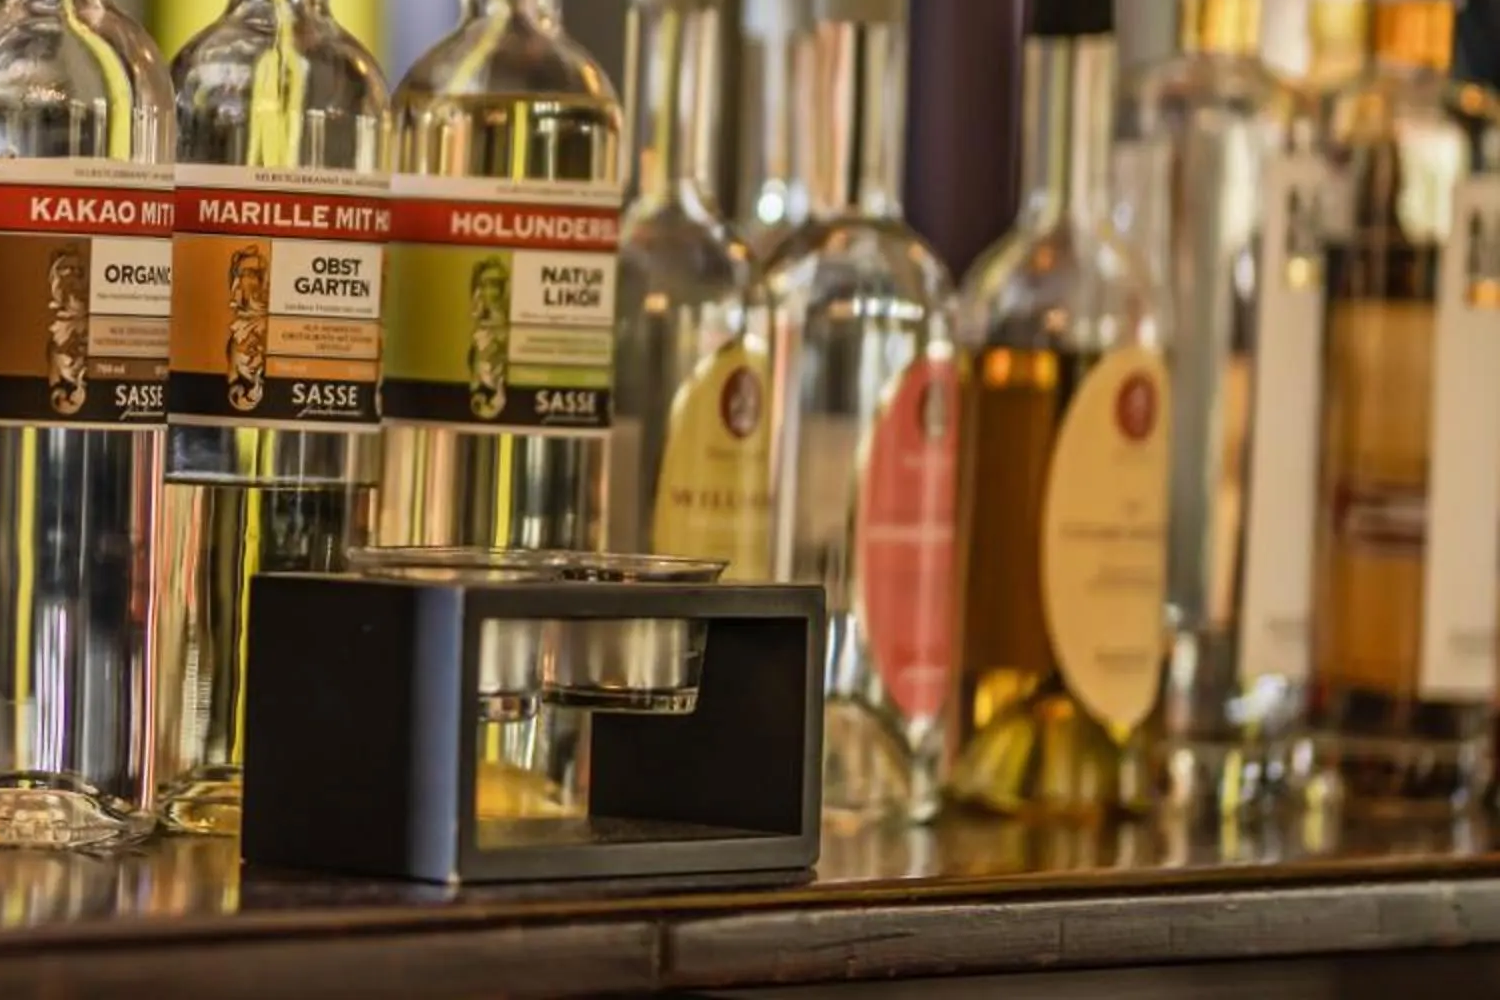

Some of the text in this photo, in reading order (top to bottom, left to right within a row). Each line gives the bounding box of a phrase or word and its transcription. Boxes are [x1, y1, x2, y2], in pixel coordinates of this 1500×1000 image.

[30, 197, 136, 225] KAKAO
[200, 200, 330, 229] MARILLE
[335, 206, 373, 232] MIT
[312, 257, 362, 276] OBST
[294, 277, 370, 297] GARTEN
[115, 384, 163, 407] SASSE
[292, 383, 358, 406] SASSE
